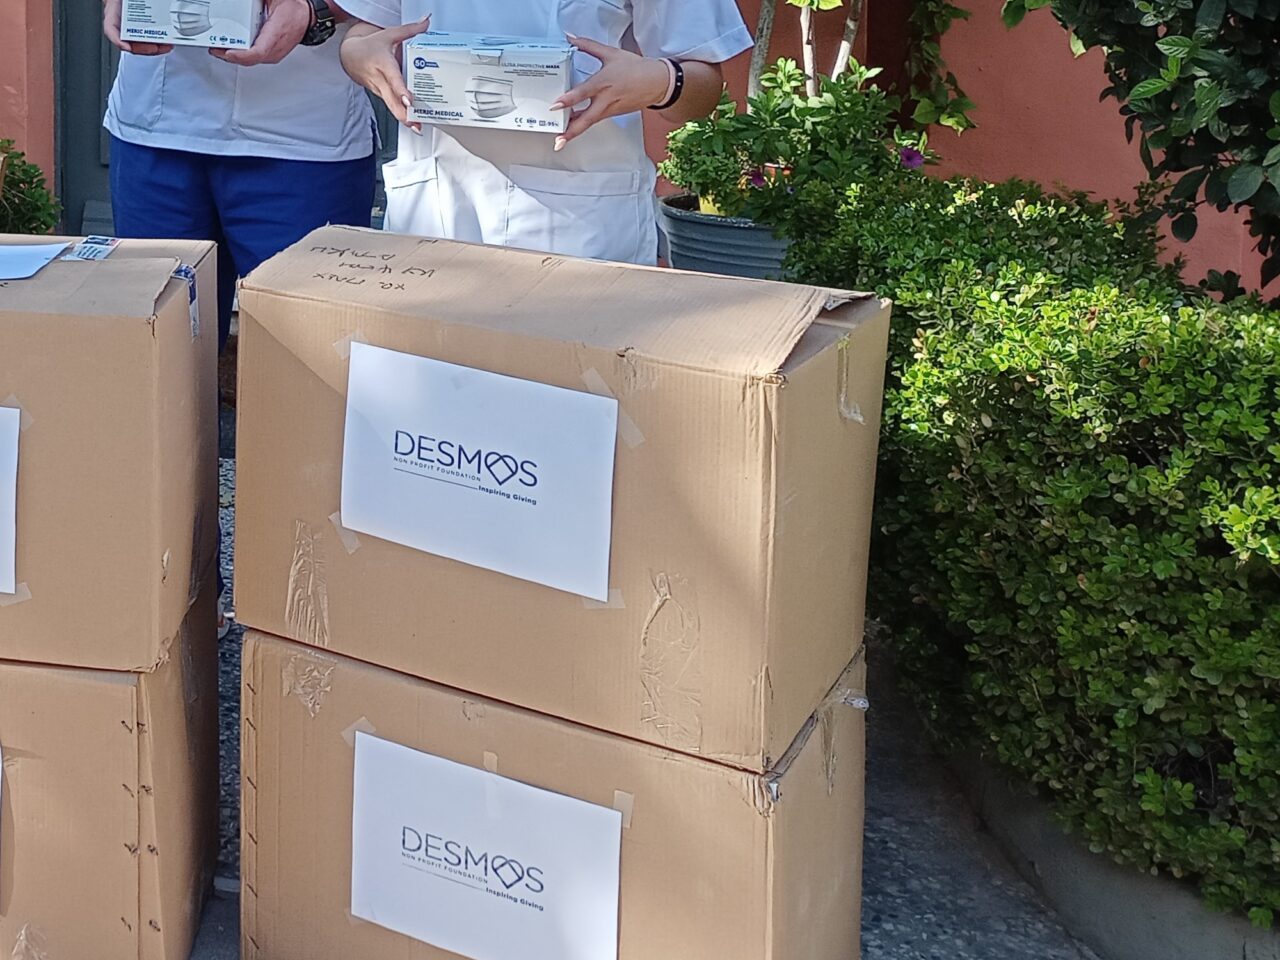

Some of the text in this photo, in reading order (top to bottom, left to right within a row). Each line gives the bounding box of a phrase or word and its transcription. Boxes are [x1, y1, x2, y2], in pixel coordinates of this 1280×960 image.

[436, 467, 481, 481] FOUNDATION
[478, 485, 537, 506] Inspiring Giving
